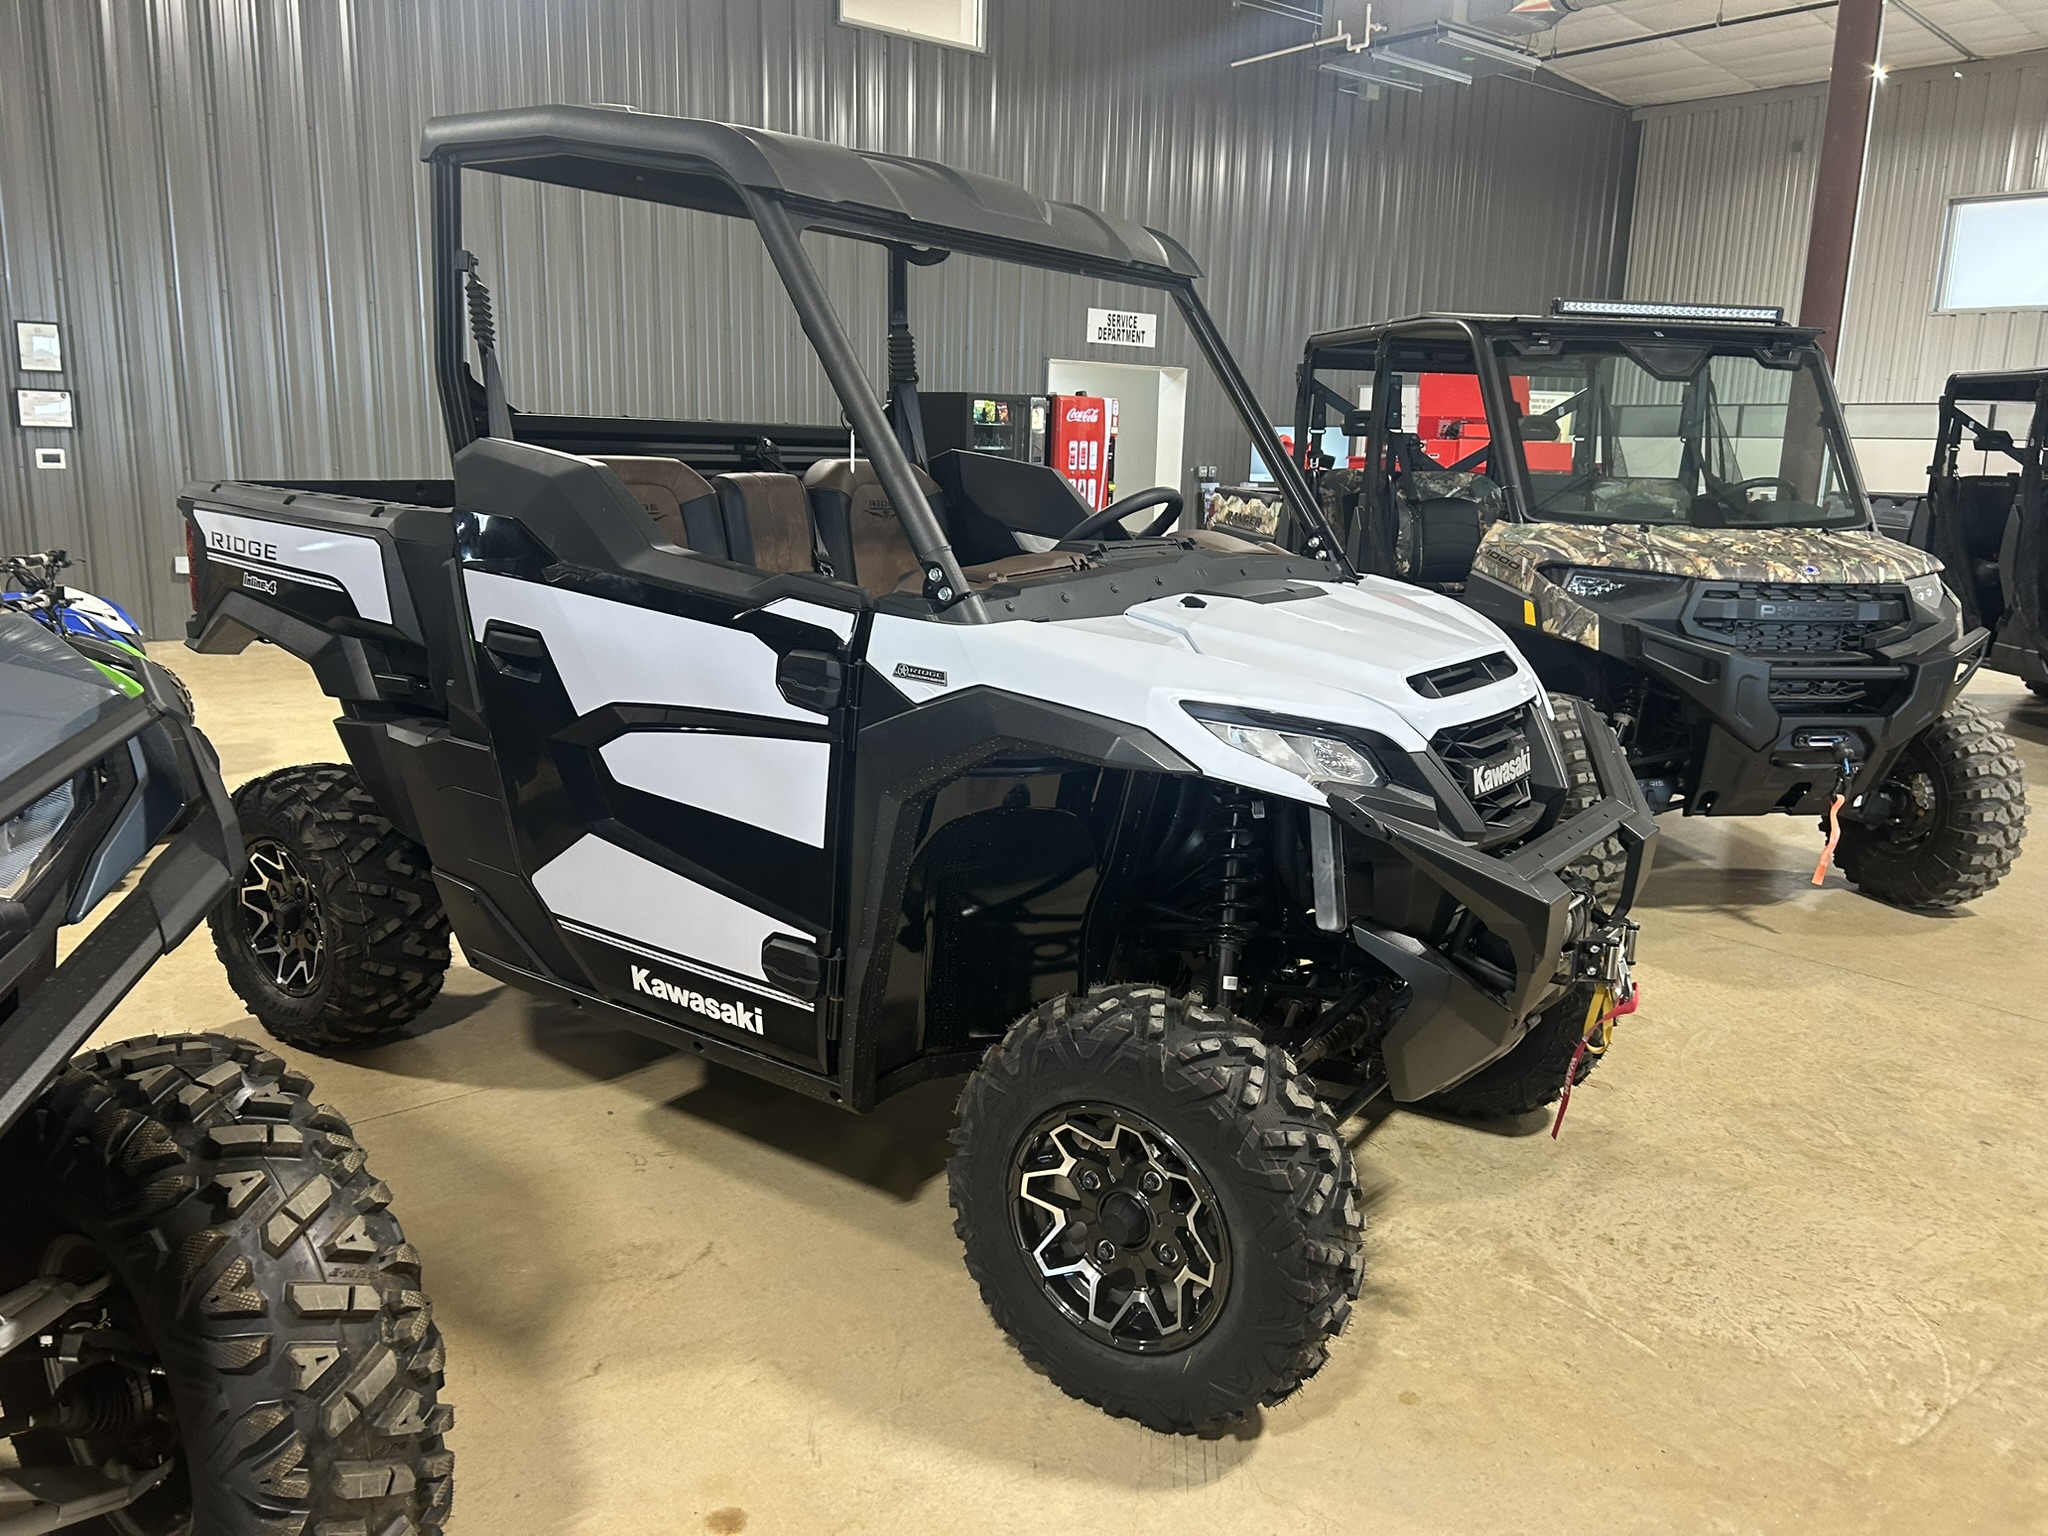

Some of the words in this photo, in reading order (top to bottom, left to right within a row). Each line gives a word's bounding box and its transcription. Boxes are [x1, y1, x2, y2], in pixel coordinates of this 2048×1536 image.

[1107, 313, 1138, 329] SERVICE
[1098, 326, 1145, 343] DEPARTMENT
[1225, 510, 1262, 528] RANGER
[211, 531, 277, 561] RIDGE
[1486, 534, 1537, 560] XP
[1486, 549, 1521, 570] 1000
[243, 572, 277, 595] Inline-4
[909, 667, 944, 679] RIDGE
[1473, 746, 1531, 796] Kawasaki
[630, 964, 765, 1036] Kawasaki
